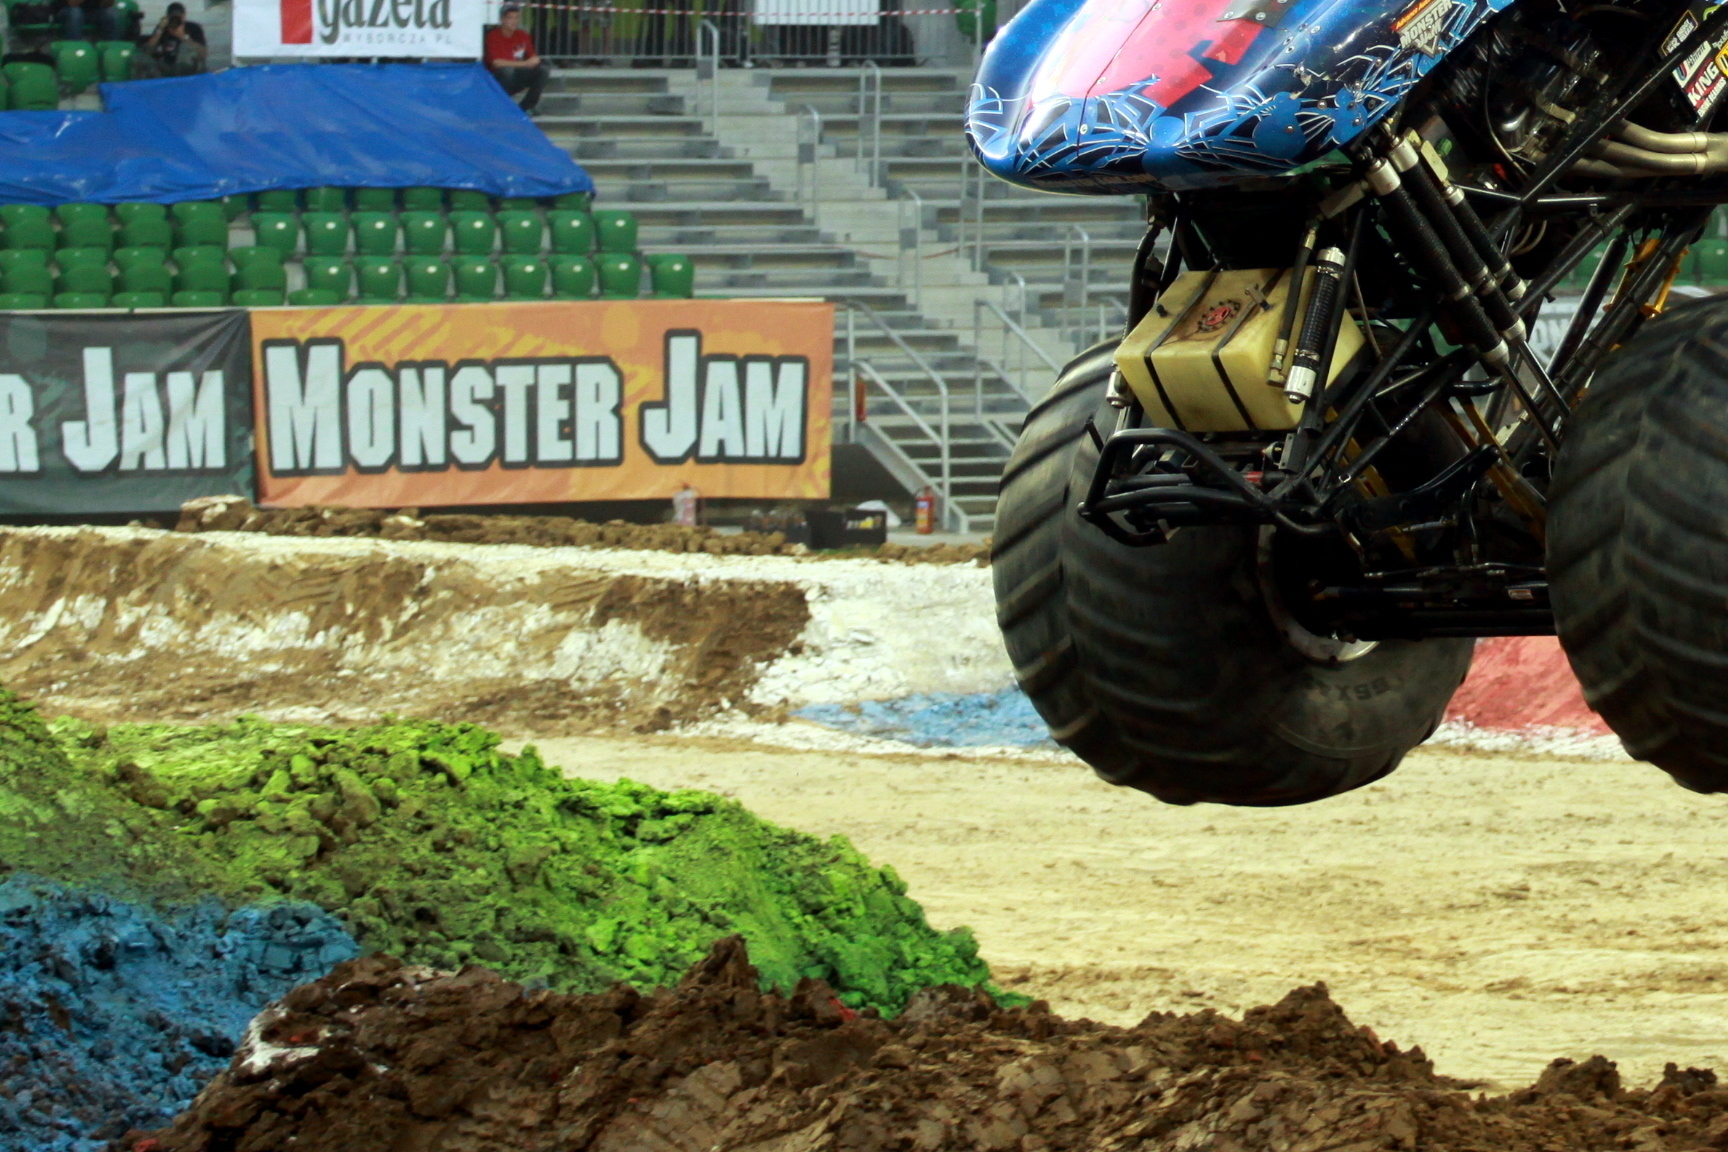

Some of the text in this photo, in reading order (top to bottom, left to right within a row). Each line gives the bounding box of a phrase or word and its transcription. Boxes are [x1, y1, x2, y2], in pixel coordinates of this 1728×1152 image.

[1687, 61, 1720, 107] KING
[61, 345, 226, 473] JAM
[264, 330, 807, 475] MONSTER JAM
